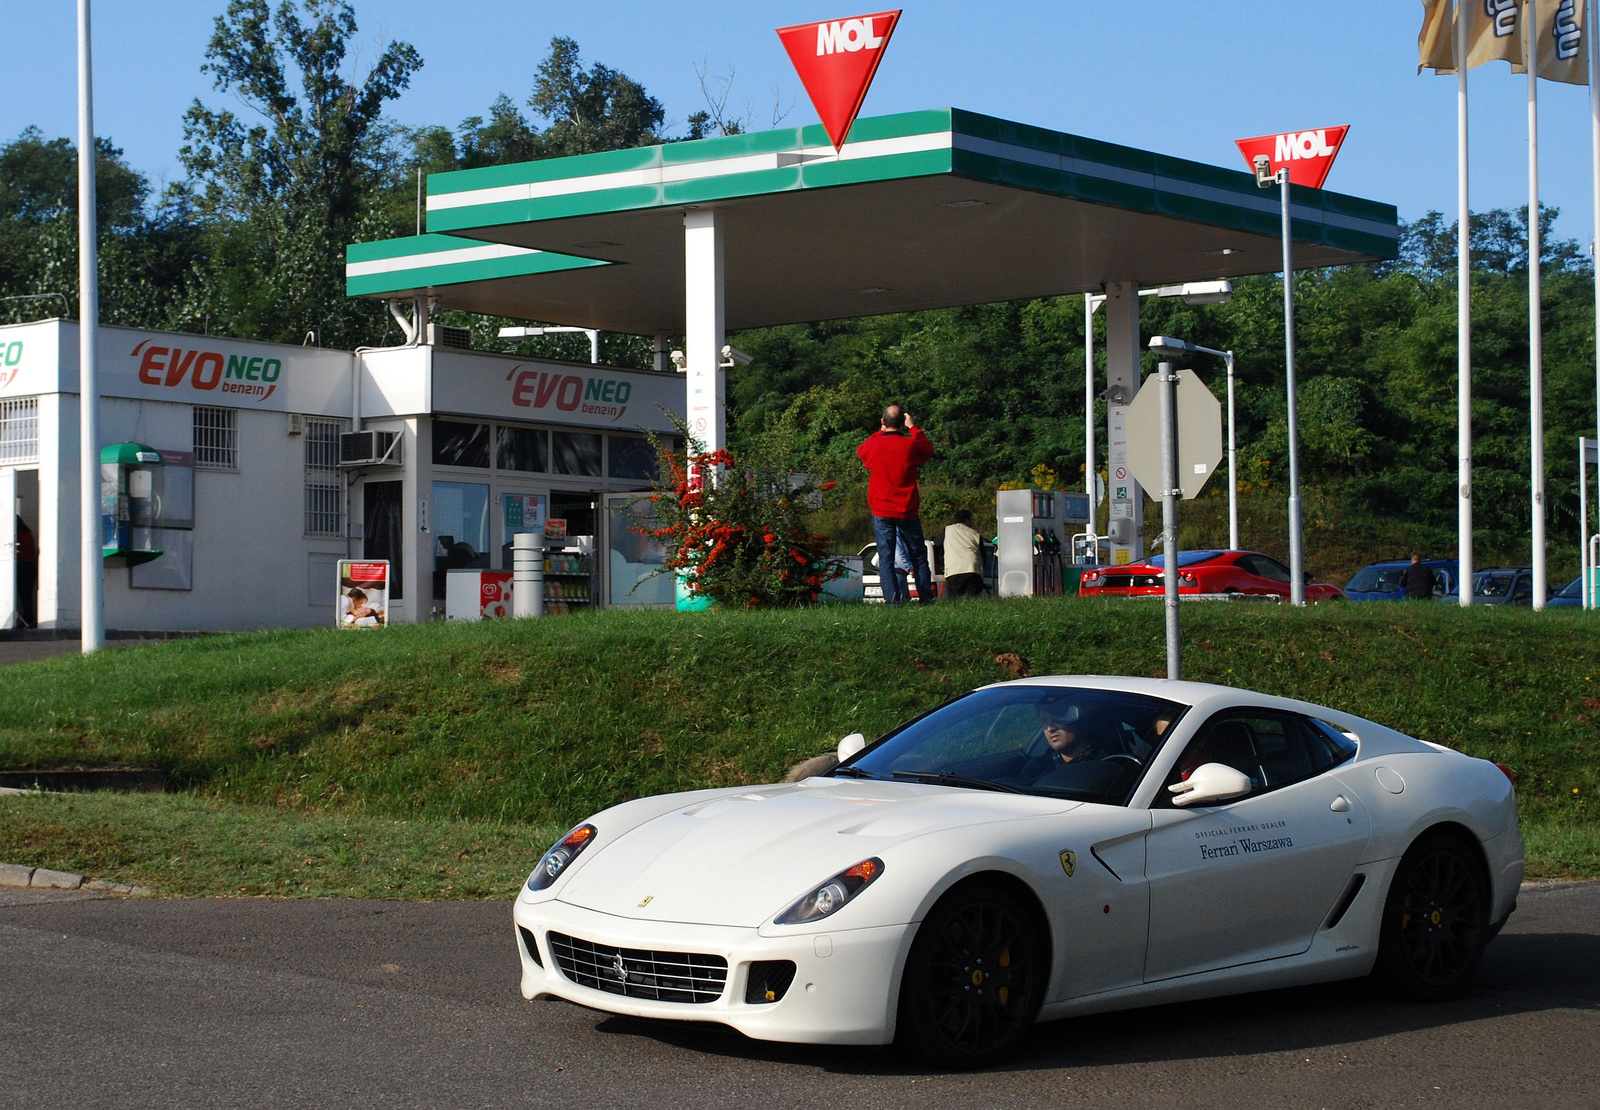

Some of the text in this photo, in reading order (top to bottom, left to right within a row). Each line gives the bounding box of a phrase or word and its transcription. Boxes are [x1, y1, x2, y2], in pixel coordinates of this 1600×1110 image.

[816, 17, 884, 56] MOL
[1274, 130, 1336, 162] MOL
[138, 346, 281, 391] EVO NEO
[221, 381, 265, 396] benzin
[512, 371, 631, 411] EVO NEO
[1195, 820, 1286, 838] OFFICIAL FERRARI DEALER
[1200, 837, 1293, 859] Ferrari Warszawa
